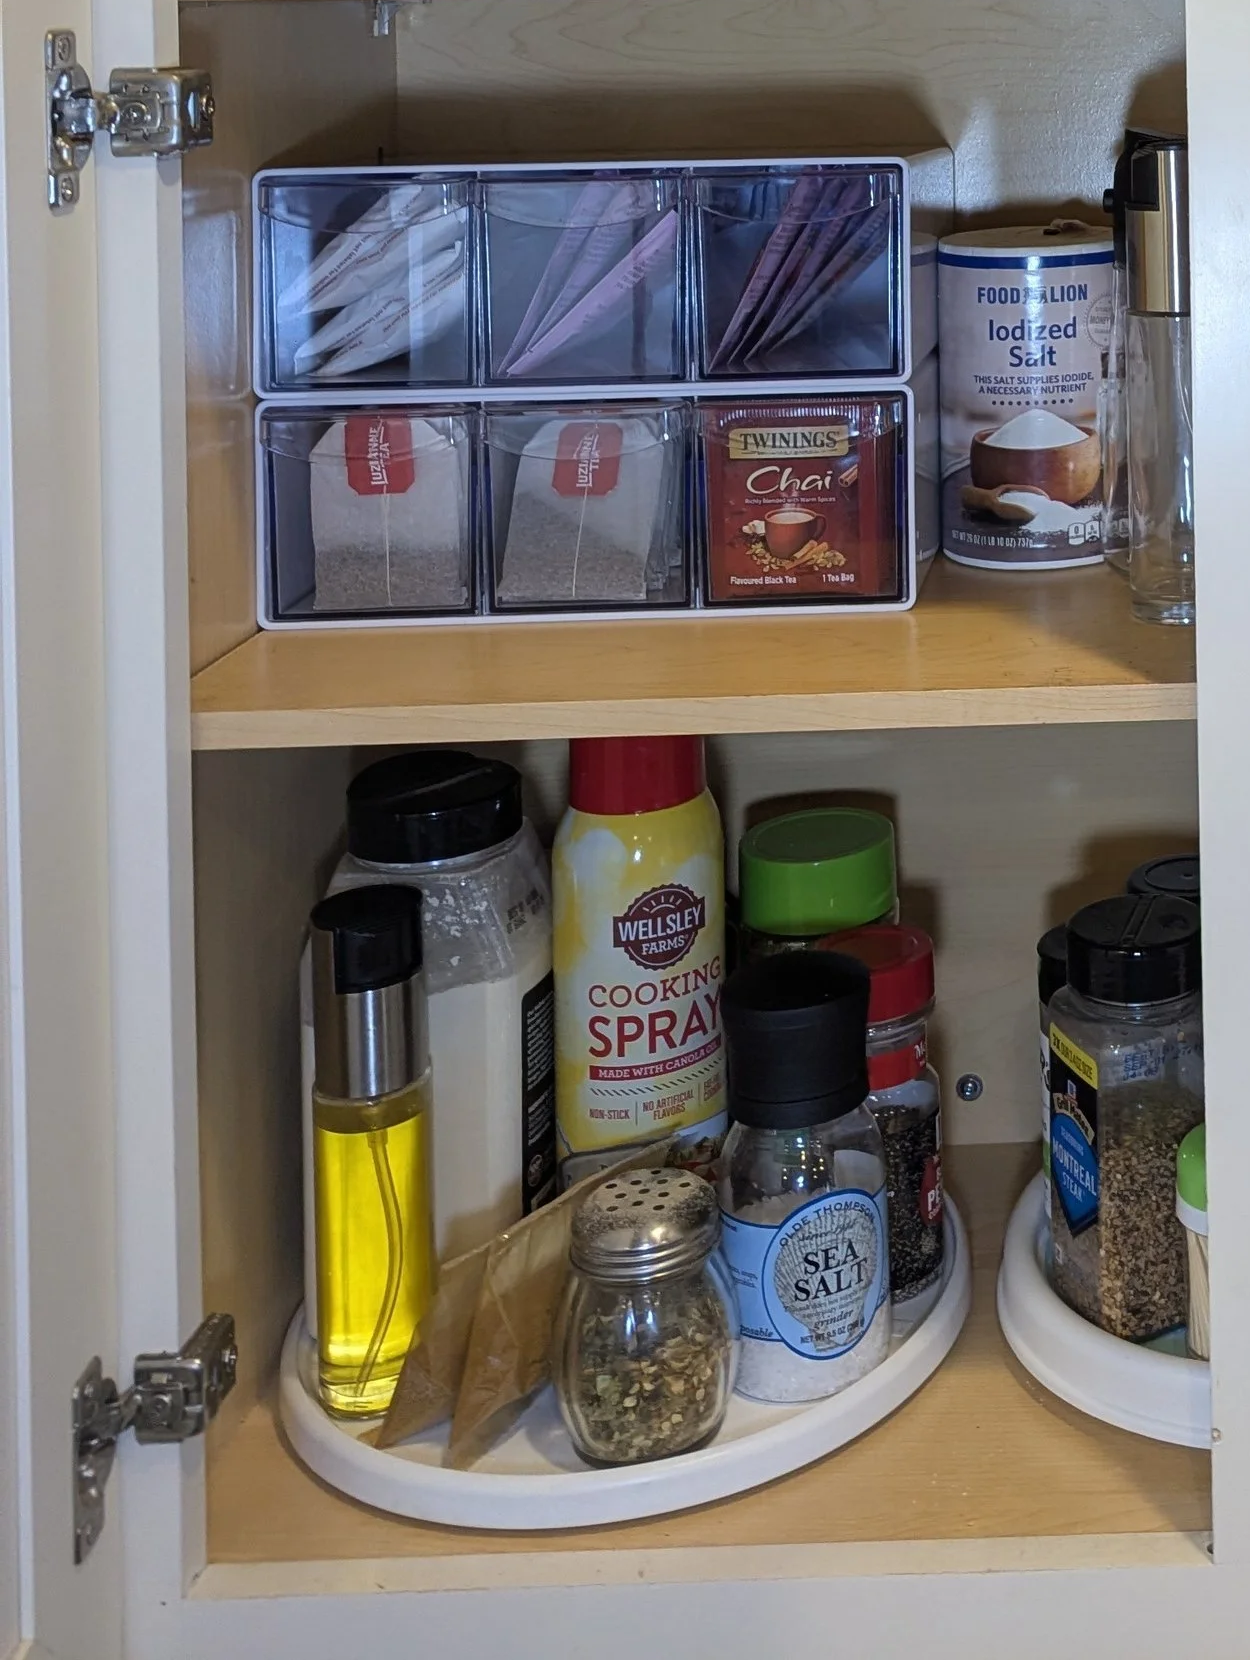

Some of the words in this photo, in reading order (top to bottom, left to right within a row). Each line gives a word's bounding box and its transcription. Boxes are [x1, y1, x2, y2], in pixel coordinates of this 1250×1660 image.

[977, 286, 1021, 304] FOOD
[1049, 283, 1088, 303] LION
[988, 315, 1077, 341] Iodized
[1009, 344, 1057, 368] Salt
[974, 374, 993, 385] THIS
[993, 375, 1015, 385] SALT
[1016, 374, 1060, 385] SUPPLIES
[1061, 371, 1094, 383] IODIDE,
[978, 386, 986, 395] A
[986, 386, 1038, 396] NECESSARY
[1040, 383, 1087, 394] NUTRIENT
[739, 431, 839, 451] TWININGS
[746, 465, 834, 495] Chai
[730, 575, 764, 586] Flavoured
[765, 575, 784, 585] Black
[784, 575, 797, 584] Tea
[828, 573, 840, 582] Tea
[840, 572, 855, 583] Bag
[618, 903, 702, 942] WELLSLEY
[641, 934, 686, 956] FARMS
[588, 955, 721, 1009] COOKING
[588, 985, 722, 1058] SPRAY
[598, 1068, 630, 1079] MADE
[632, 1064, 664, 1077] WITH
[665, 1053, 706, 1070] CANOLA
[642, 1100, 655, 1113] NO
[655, 1089, 695, 1110] ARTIFICIAL
[653, 1103, 686, 1121] FLAVORS
[589, 1108, 631, 1120] NON-STICK
[1051, 1136, 1098, 1197] MONTREAL
[1062, 1171, 1083, 1202] STEAK
[779, 1215, 810, 1247] OLDE
[813, 1200, 876, 1223] THOMPSON
[803, 1240, 859, 1276] SEA
[794, 1258, 868, 1302] SALT
[813, 1309, 855, 1330] grinder
